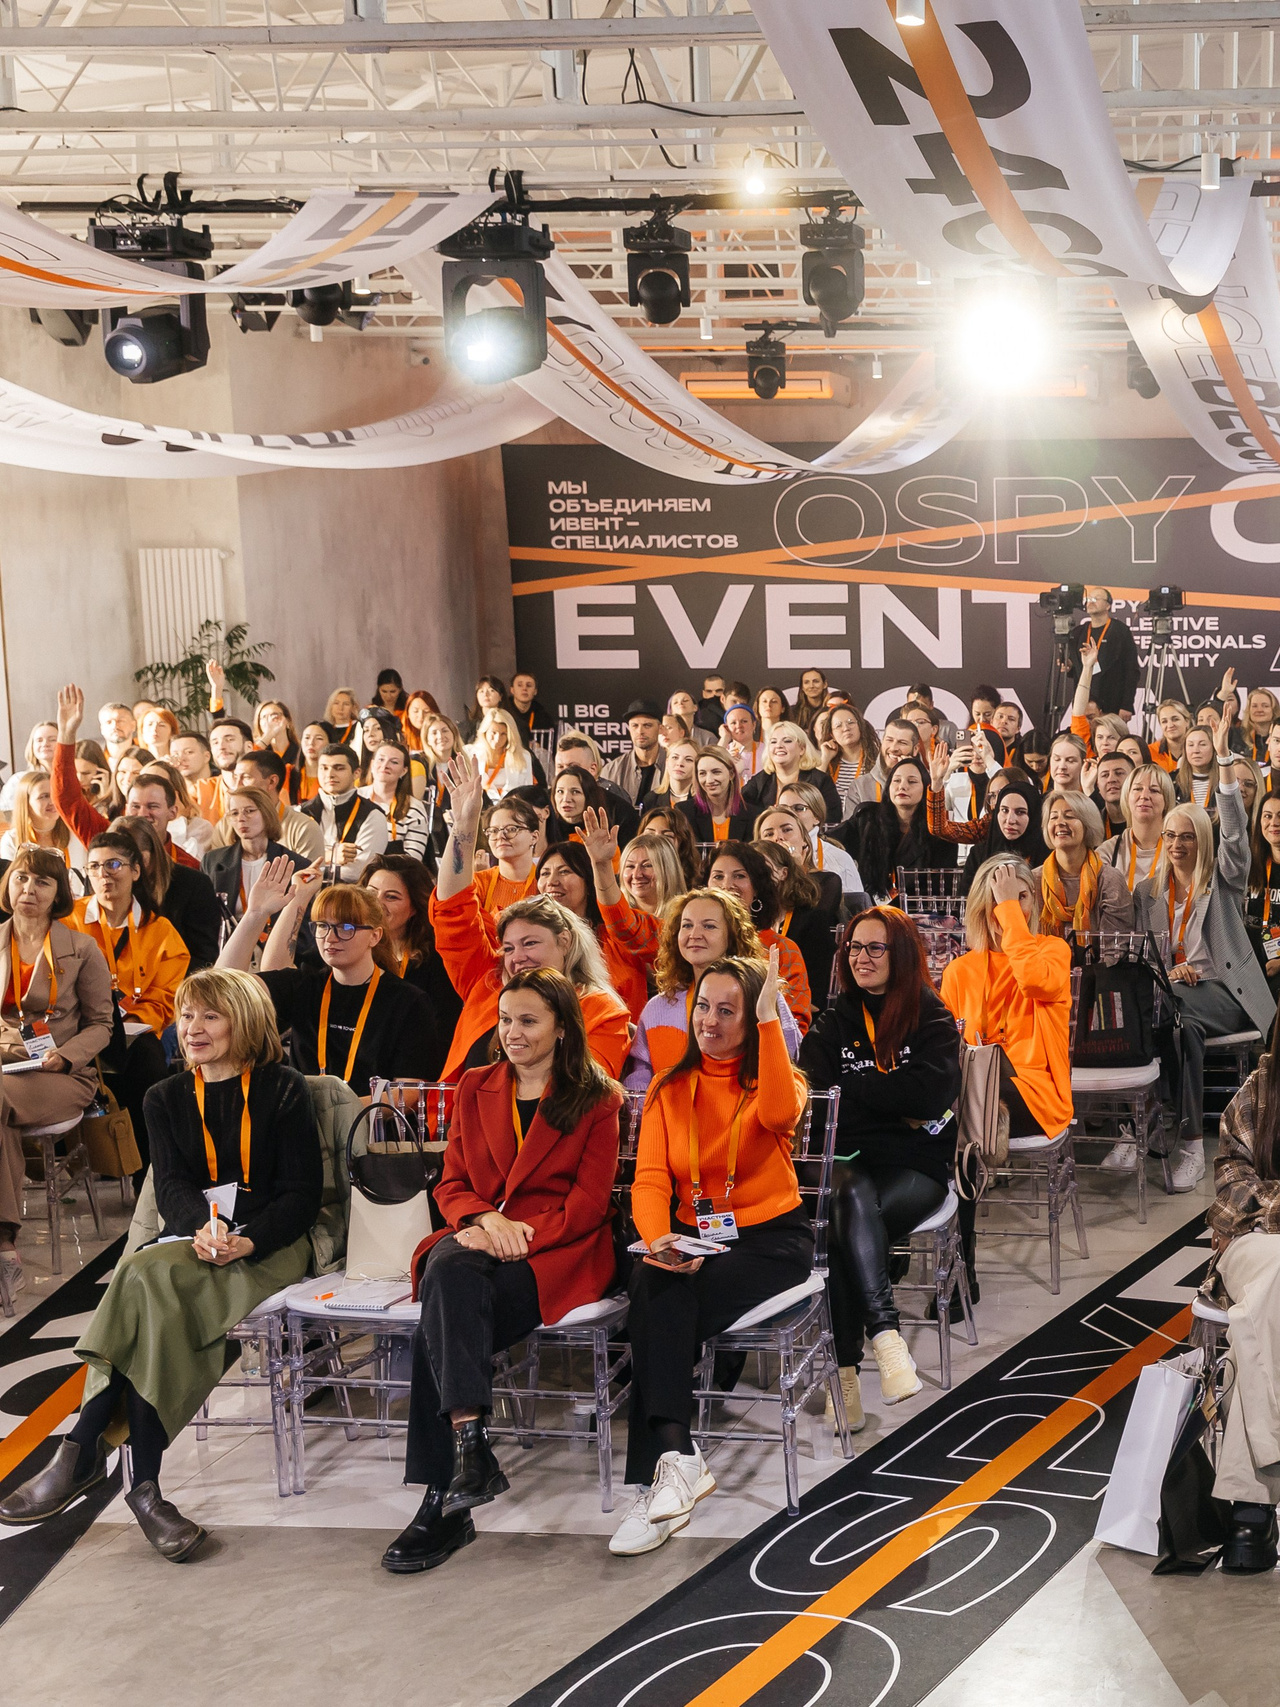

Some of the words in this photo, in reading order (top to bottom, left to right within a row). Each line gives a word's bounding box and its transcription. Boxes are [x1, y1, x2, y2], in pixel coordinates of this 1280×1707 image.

[547, 481, 588, 495] МЫ
[549, 498, 711, 515] ОБЪЕДИНЯЕМ
[772, 474, 1196, 568] OSPY
[551, 534, 739, 551] СПЕЦИАЛИСТОВ
[551, 583, 1040, 670] EVENT
[574, 704, 610, 718] BIG
